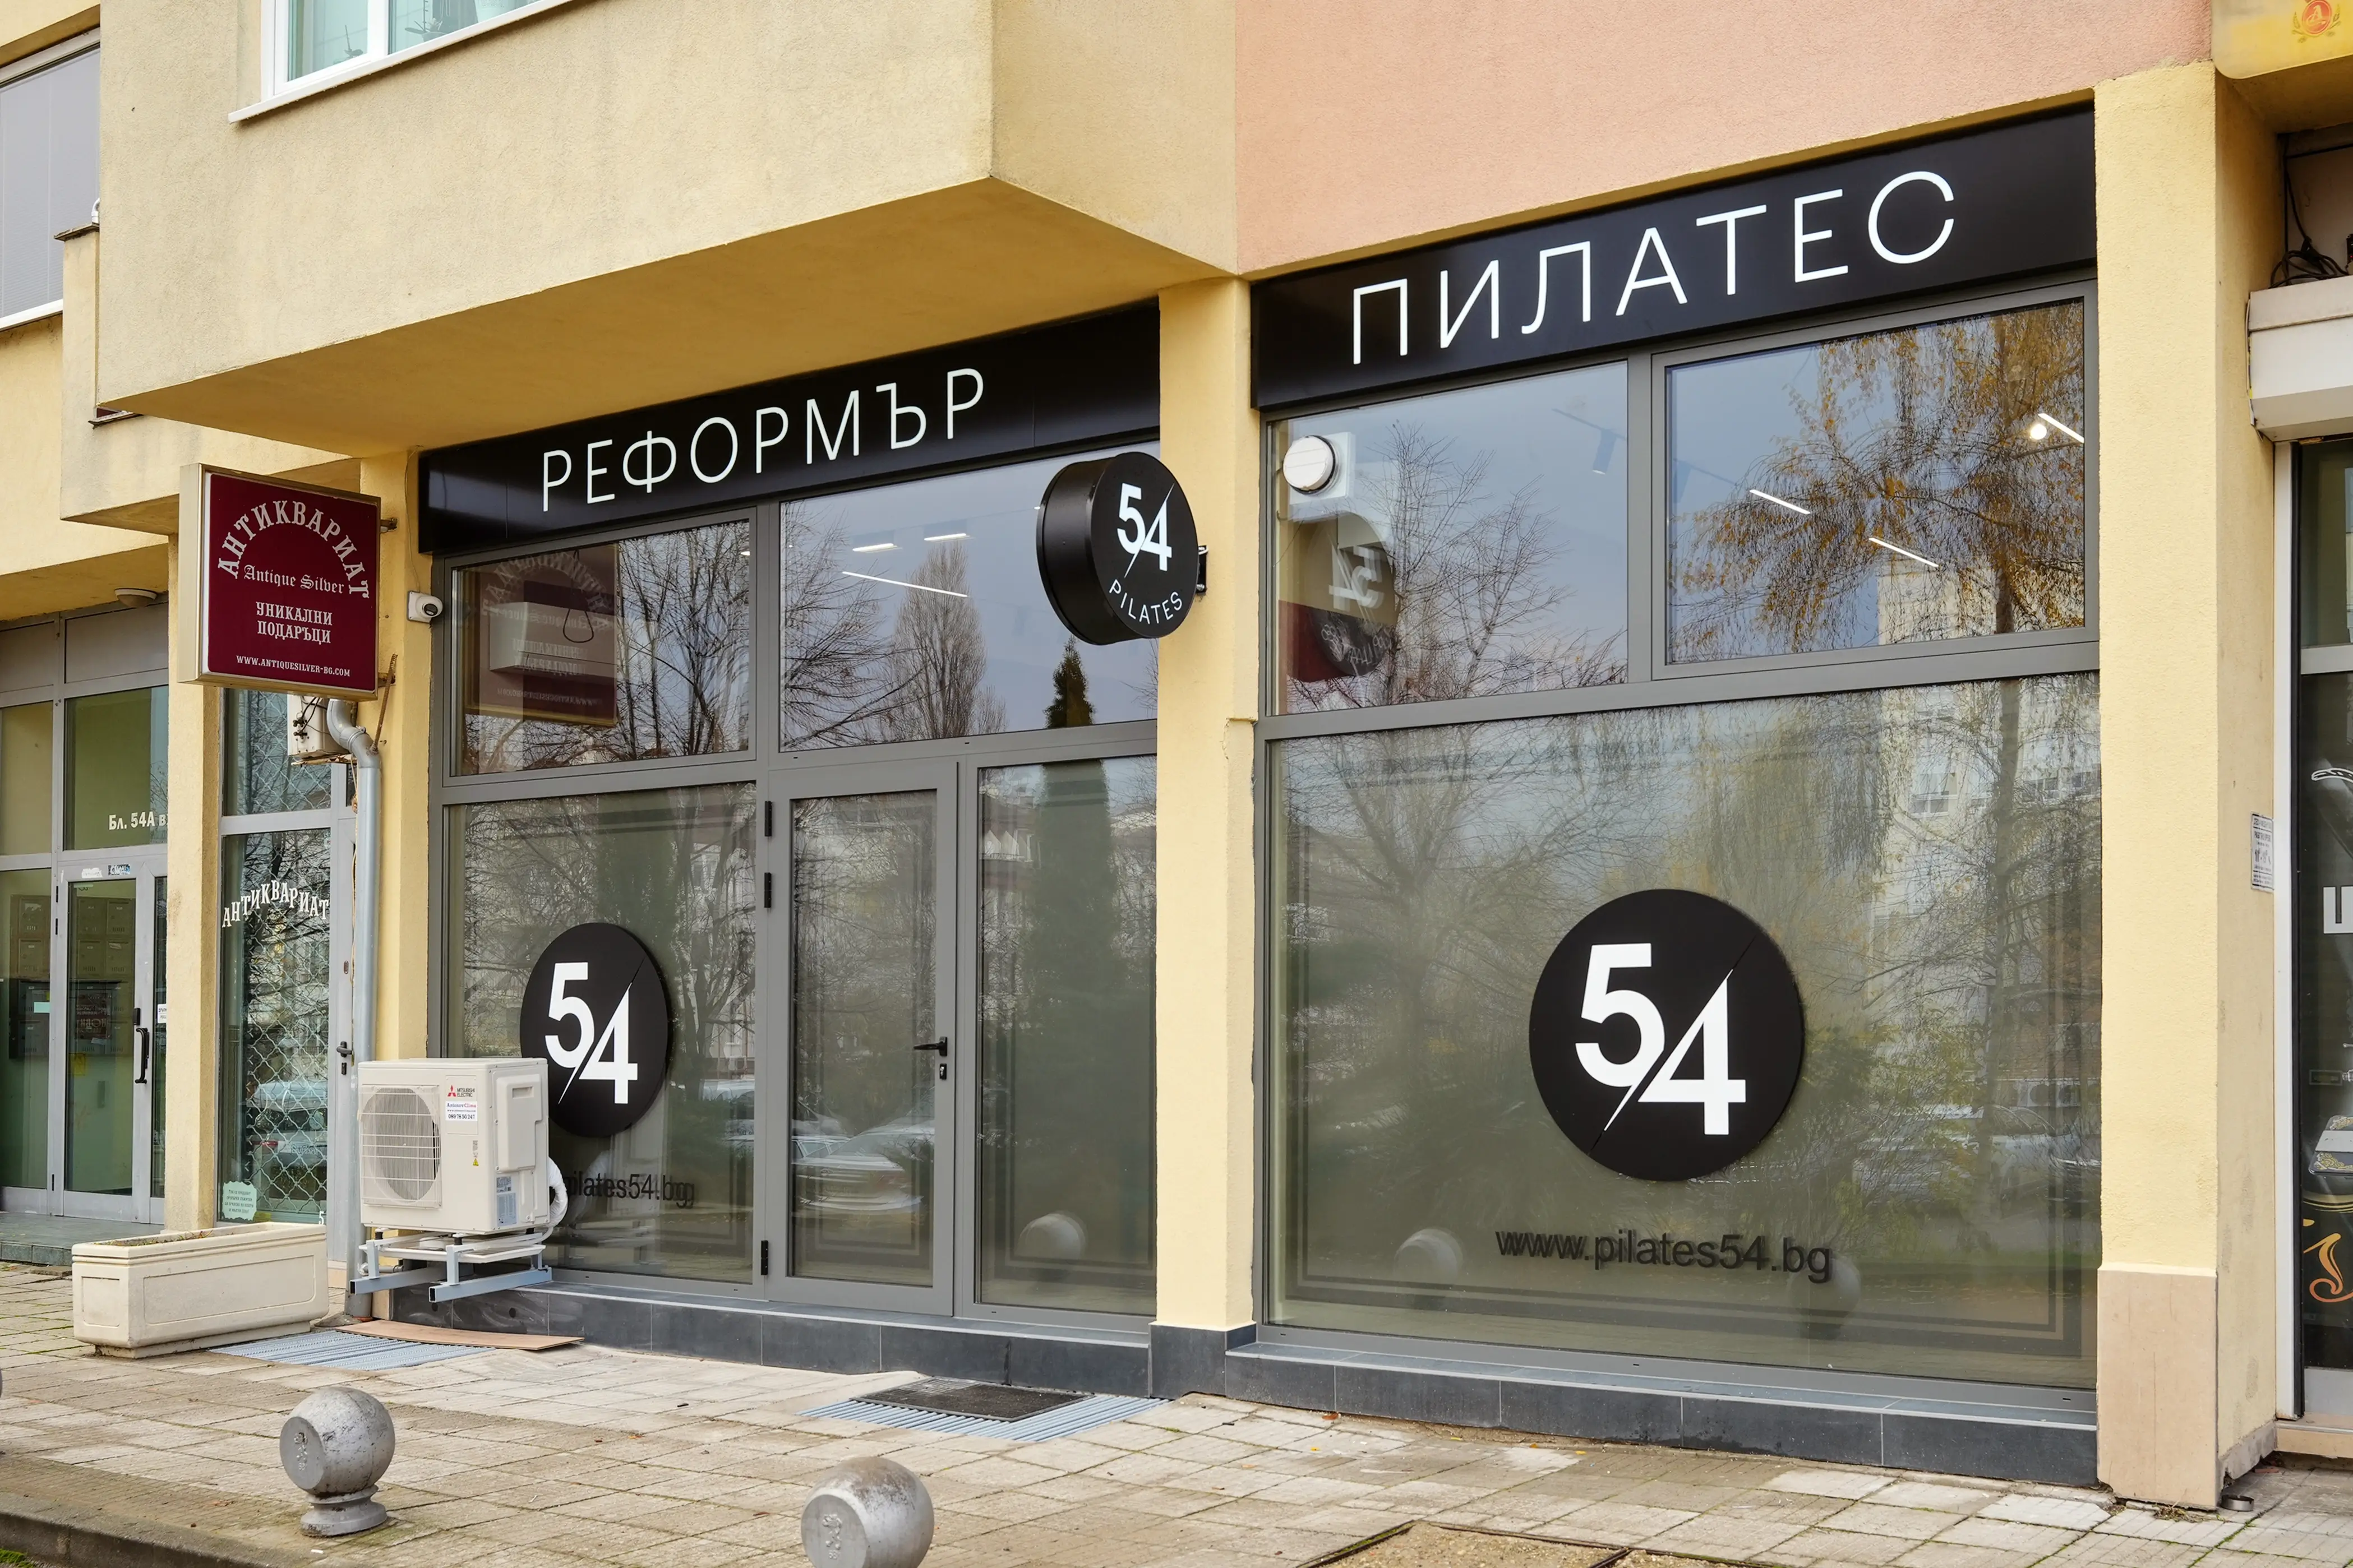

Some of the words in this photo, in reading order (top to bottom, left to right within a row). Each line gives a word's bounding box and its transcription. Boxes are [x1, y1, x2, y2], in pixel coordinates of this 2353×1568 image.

[1353, 171, 1954, 364] ПИЛАТЕС
[542, 368, 984, 512] РЕФОРМЪР
[218, 501, 369, 598] АНТИКВАРИАТ
[244, 565, 296, 586] Antique
[300, 575, 344, 594] Silver
[1109, 579, 1183, 625] PILATES
[256, 602, 333, 625] УНИКАЛНИ
[257, 620, 331, 645] ПОДАРЪЦИ
[236, 655, 350, 677] WWW.ANTIQUESILVER-BG.COM
[109, 814, 127, 830] Бл.
[222, 880, 329, 928] АНТИКВАРИАТ
[1496, 1229, 1830, 1283] www.pilates54.bg
